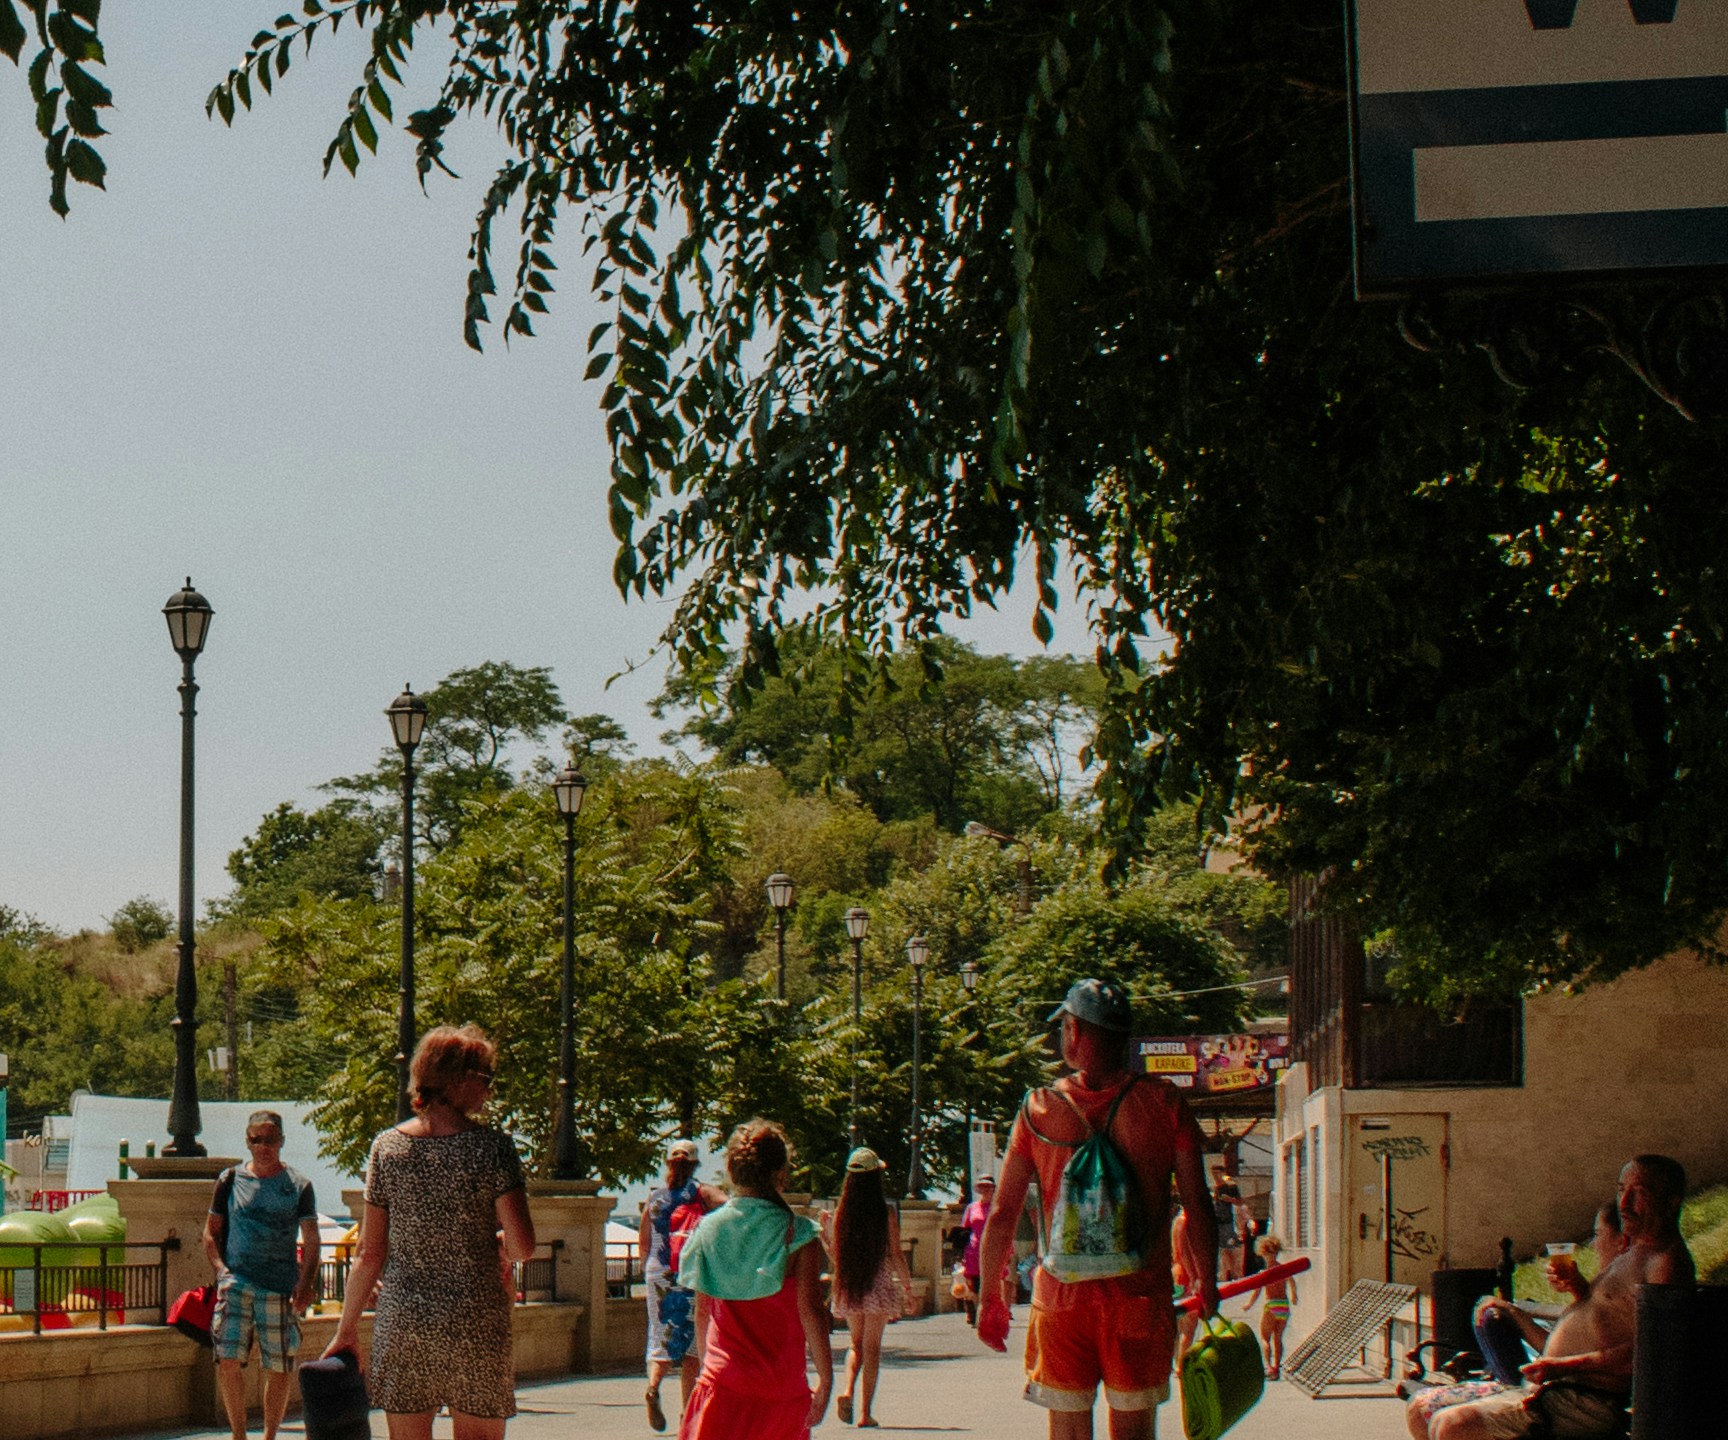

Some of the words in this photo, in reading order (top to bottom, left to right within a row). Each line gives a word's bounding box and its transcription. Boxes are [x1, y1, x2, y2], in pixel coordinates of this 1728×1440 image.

[1138, 1042, 1187, 1055] ДИСКОТЕКА
[1154, 1057, 1192, 1070] КАРАОКЕ
[1212, 1072, 1251, 1086] NON-STOP
